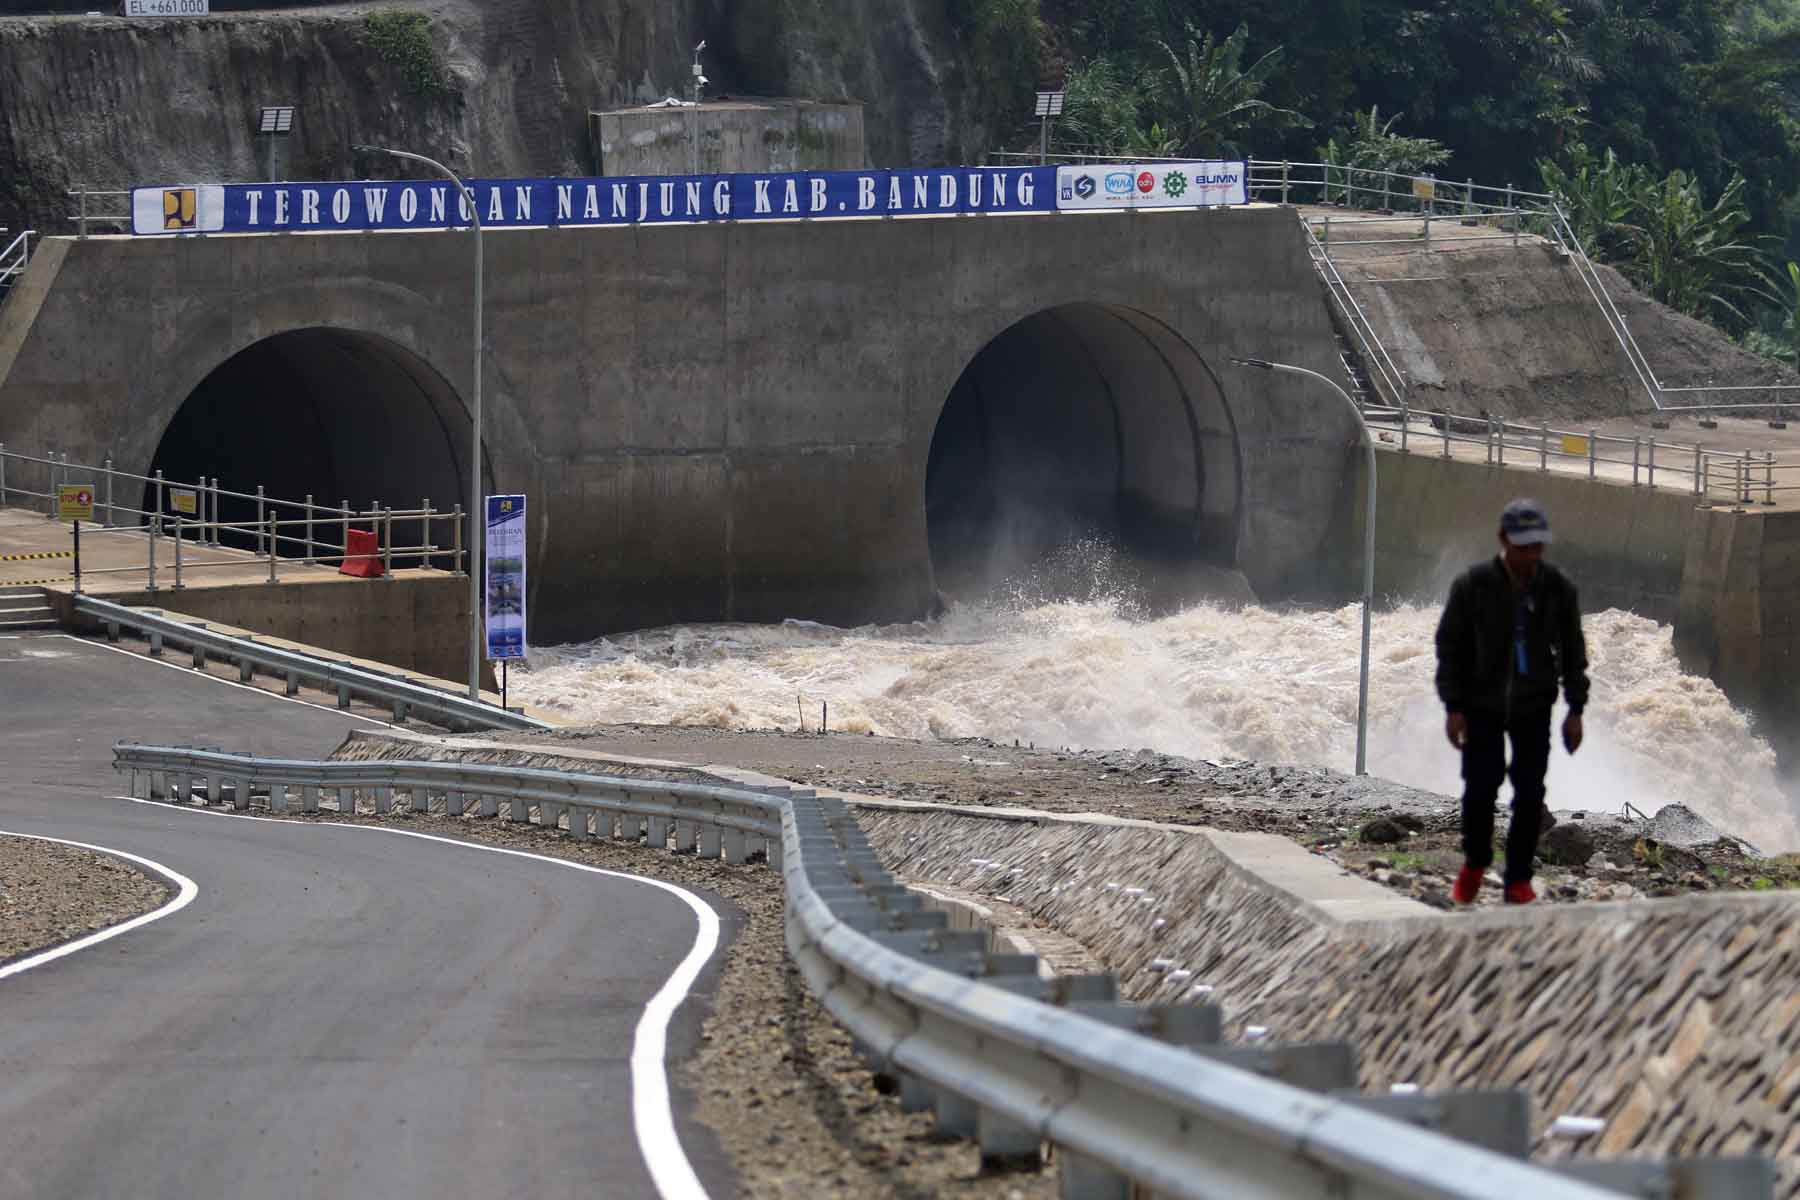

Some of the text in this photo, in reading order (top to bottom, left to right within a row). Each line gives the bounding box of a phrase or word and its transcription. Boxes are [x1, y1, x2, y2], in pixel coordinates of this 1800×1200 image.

[130, 0, 148, 14] EL
[1195, 174, 1238, 184] BUMN
[246, 186, 532, 225] TEROWONGAN
[557, 180, 731, 221] NANJUNG
